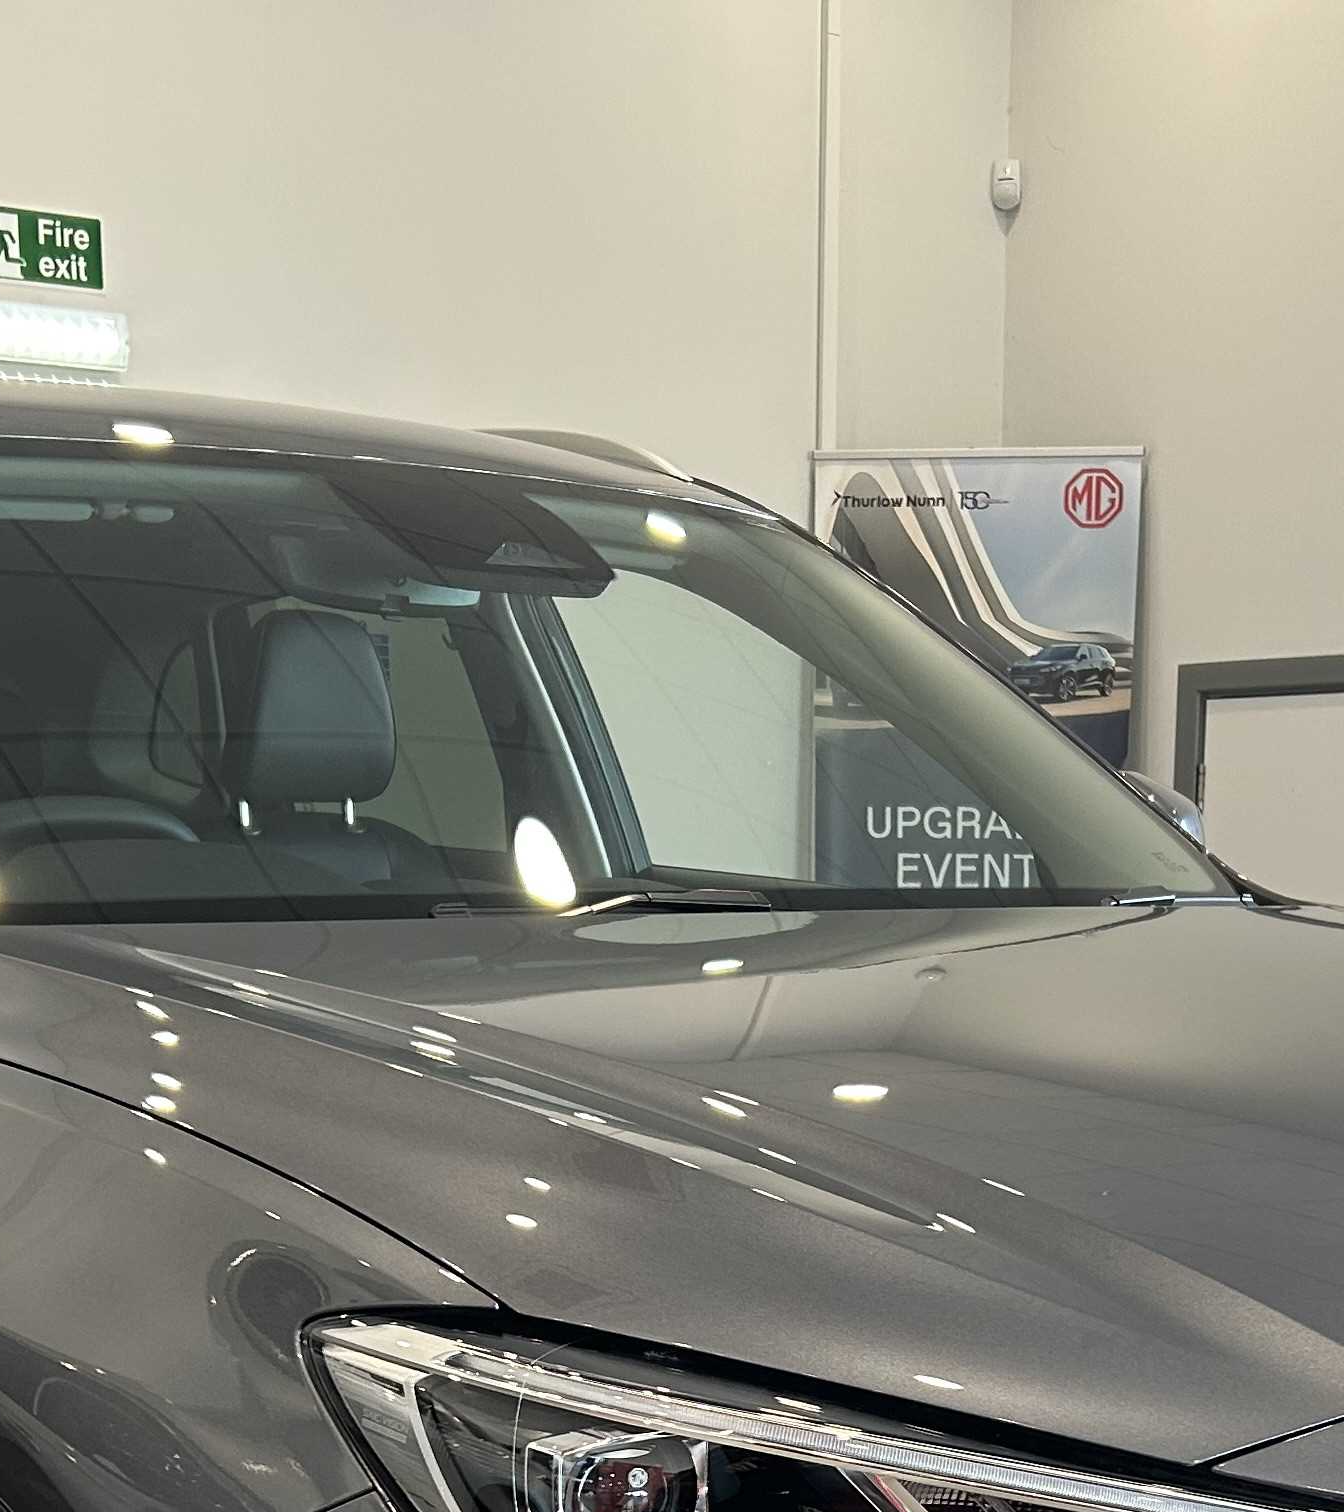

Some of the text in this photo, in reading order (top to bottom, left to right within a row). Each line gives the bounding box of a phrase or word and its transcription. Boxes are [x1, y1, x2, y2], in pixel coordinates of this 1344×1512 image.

[37, 218, 90, 250] Fire
[38, 254, 88, 282] exit
[842, 495, 903, 508] Thurlow
[906, 496, 945, 508] Nunn
[1070, 474, 1118, 522] MG
[867, 806, 1023, 839] UPGRA
[897, 853, 1034, 888] EVENT
